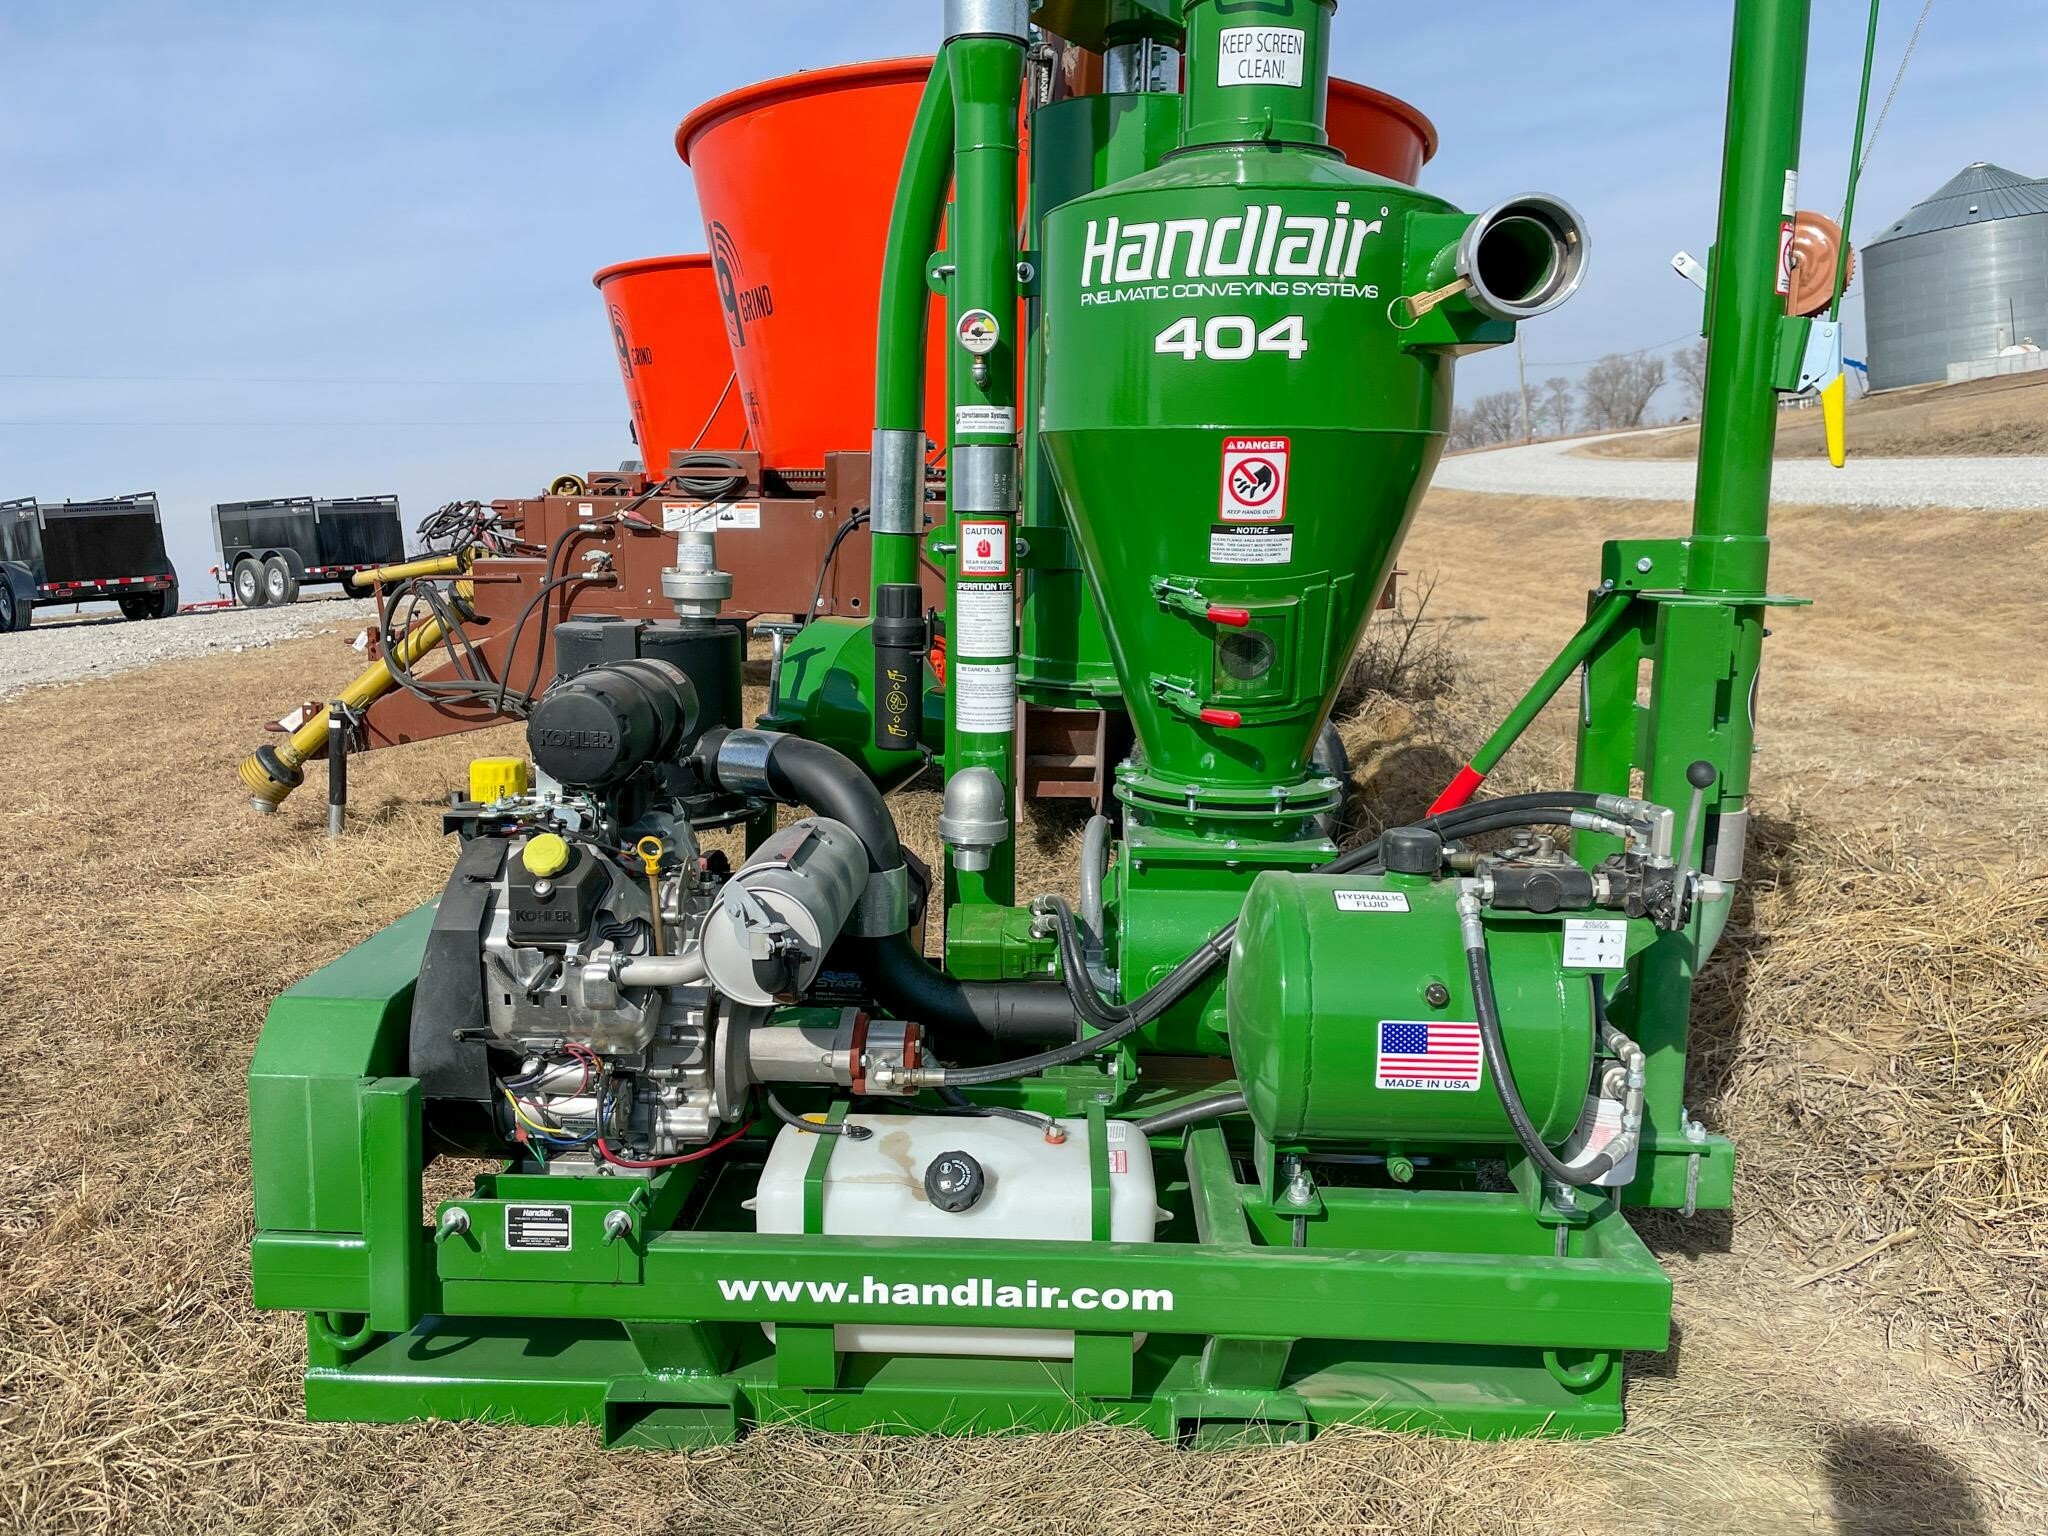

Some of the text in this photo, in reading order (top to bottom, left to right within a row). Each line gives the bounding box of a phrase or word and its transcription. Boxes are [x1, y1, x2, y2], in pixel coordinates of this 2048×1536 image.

[1222, 33, 1302, 55] KEEP SCREEN
[1238, 59, 1285, 79] CLEAN!
[1040, 67, 1048, 103] MAXIM
[739, 285, 774, 322] GRIND
[1081, 282, 1379, 306] PNEUMATIC CONVEYING SYSTEMS
[1154, 315, 1309, 361] 404
[631, 346, 652, 366] GRIND
[1236, 440, 1285, 450] DANGER
[540, 728, 614, 750] KOHLER
[1338, 894, 1403, 902] HYDRAULIC
[516, 910, 572, 922] KOHLER
[1384, 1079, 1470, 1089] MADE IN USA
[717, 1276, 1174, 1311] www.handlair.com
